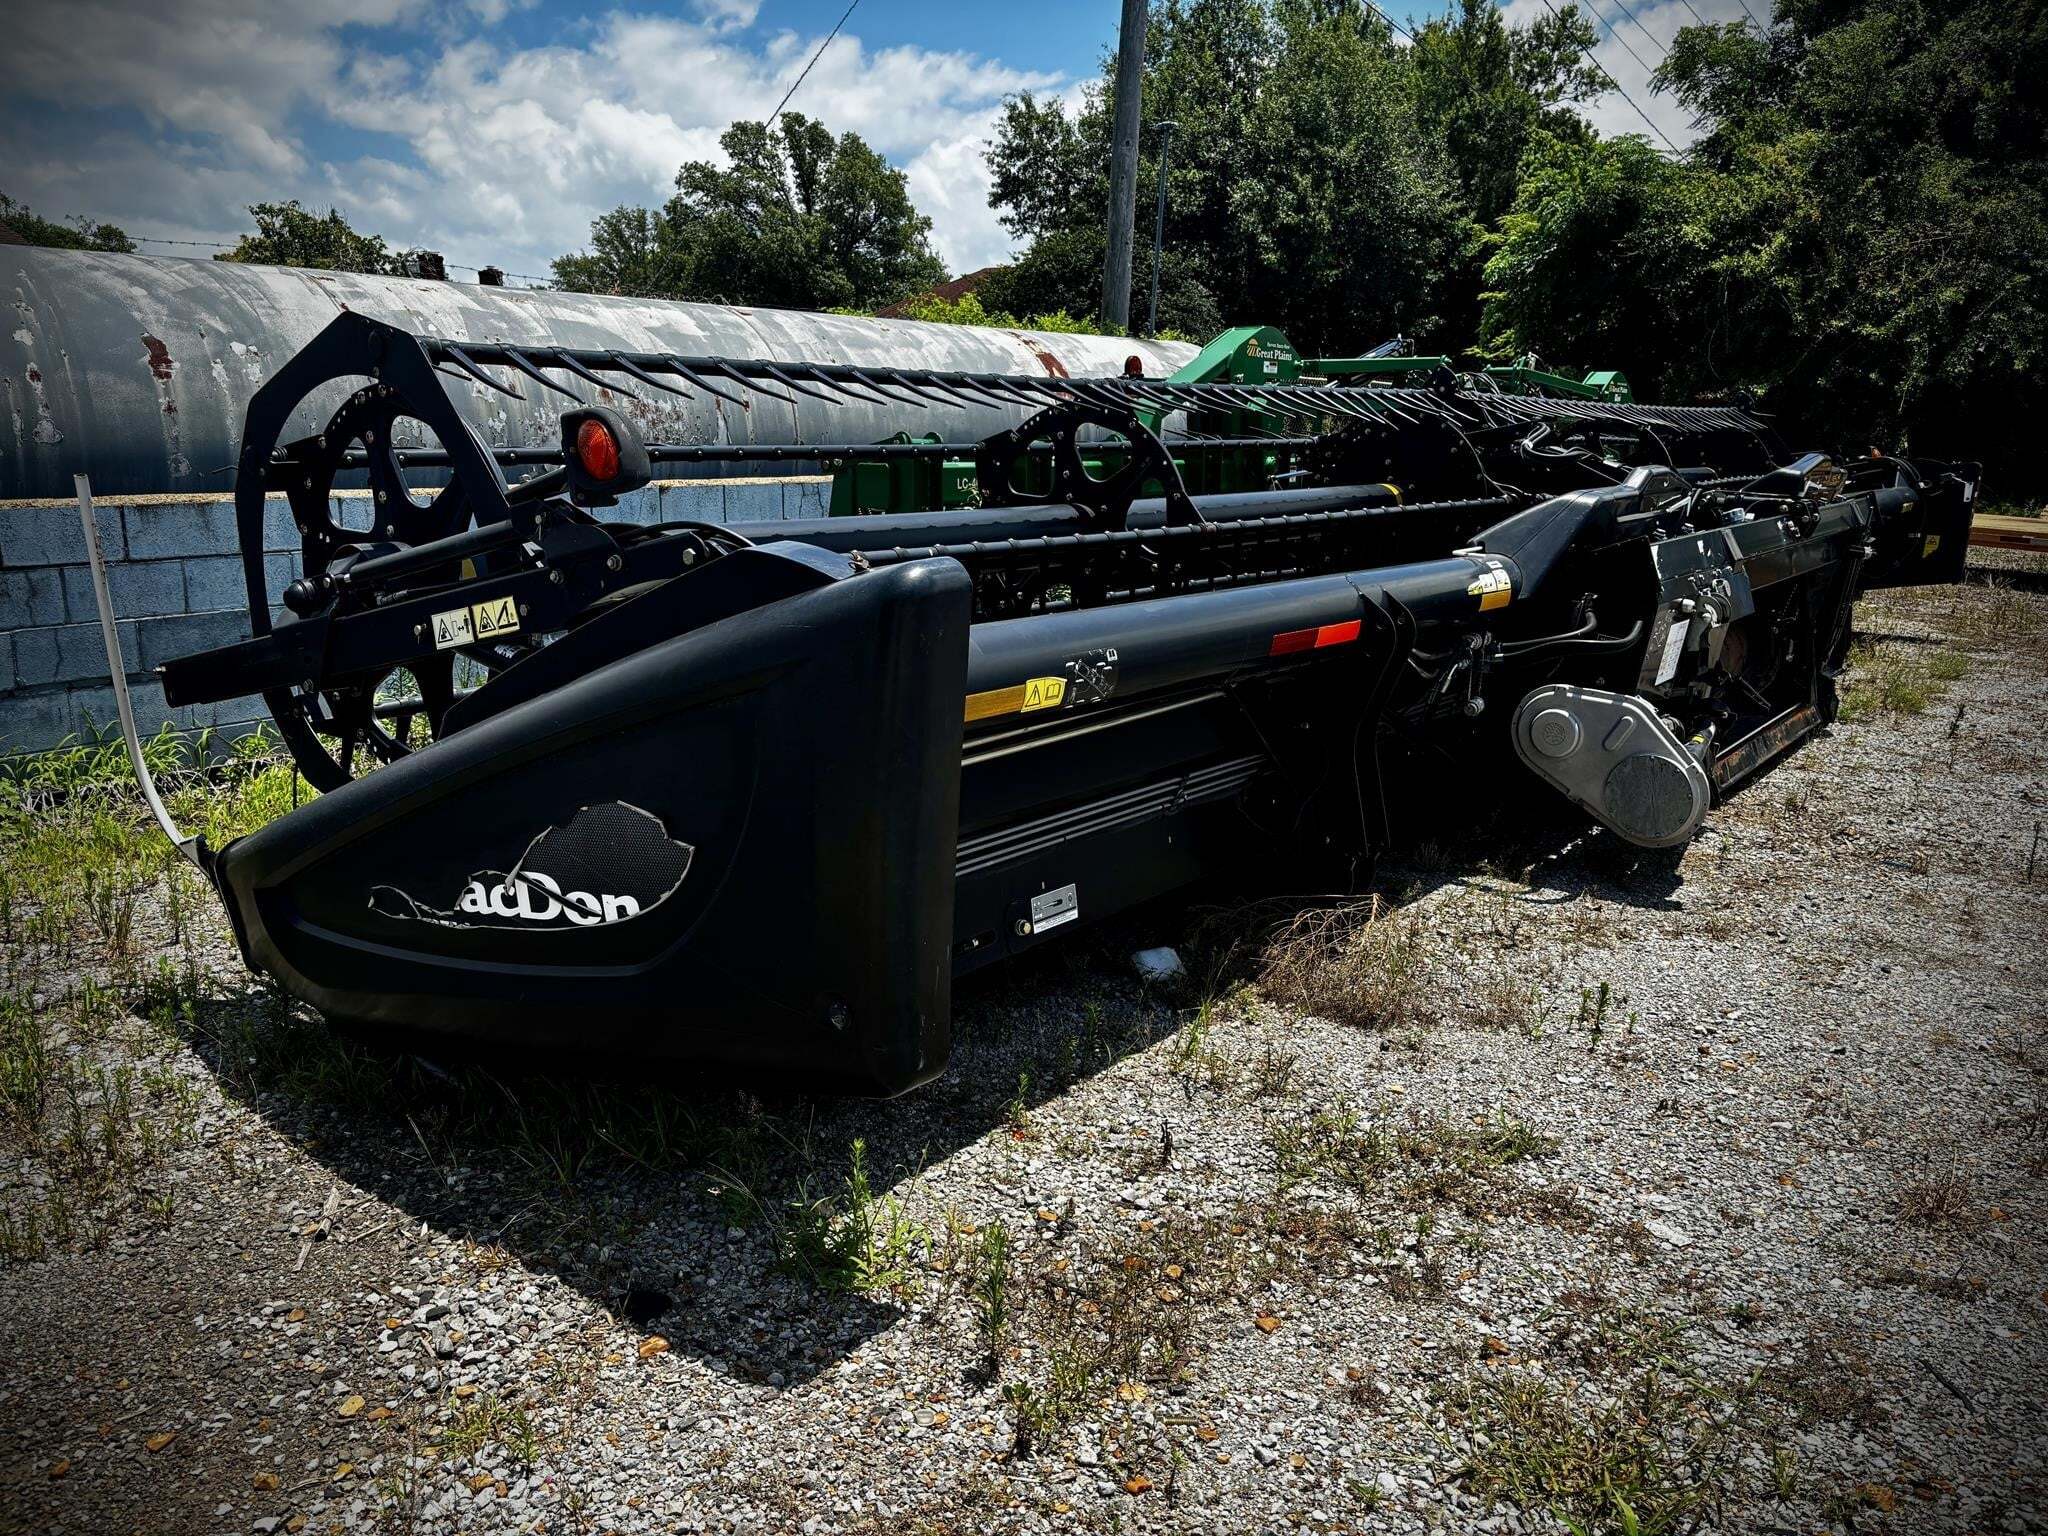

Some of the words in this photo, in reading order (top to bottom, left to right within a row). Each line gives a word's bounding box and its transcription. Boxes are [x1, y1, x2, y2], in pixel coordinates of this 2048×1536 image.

[1256, 347, 1274, 359] Great
[1274, 350, 1292, 361] Plains
[455, 871, 640, 925] acDon
